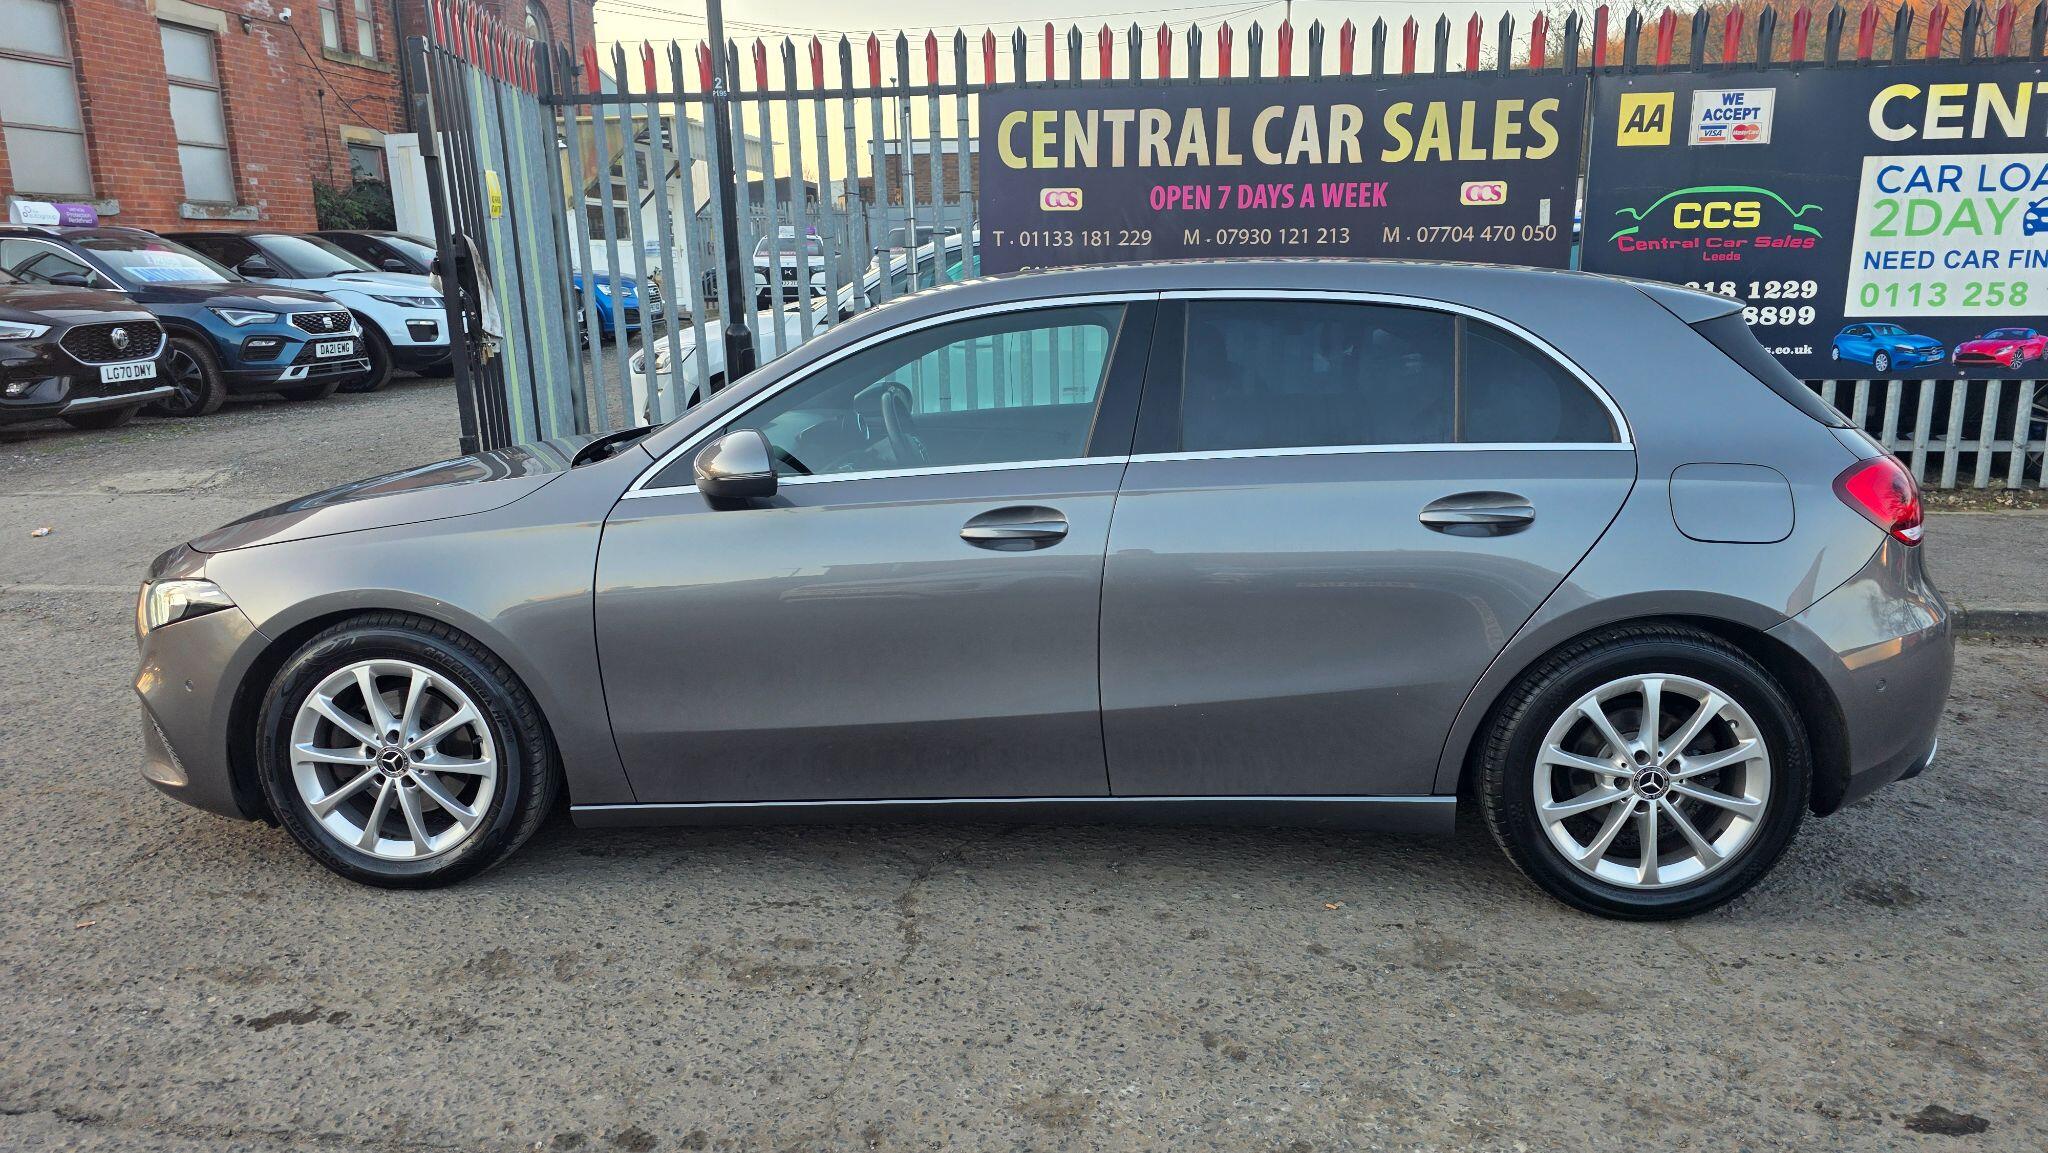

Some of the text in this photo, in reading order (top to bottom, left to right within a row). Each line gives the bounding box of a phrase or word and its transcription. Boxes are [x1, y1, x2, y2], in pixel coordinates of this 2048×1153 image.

[714, 77, 722, 89] 2
[1722, 92, 1744, 105] WE
[1623, 104, 1665, 133] AA
[1702, 107, 1761, 121] ACCEPT
[997, 98, 1560, 169] CENTRAL CAR SALES
[1704, 129, 1722, 137] VISA
[1732, 129, 1760, 137] MasterCard
[1876, 162, 2048, 194] CAR LOA
[1044, 191, 1078, 208] CCS
[1150, 181, 1389, 211] OPEN 7 DAYS A WEEK
[1465, 184, 1502, 202] CCS
[1673, 201, 1760, 229] CCS
[1870, 197, 2020, 237] 2DAY
[1019, 230, 1073, 247] 01133
[1081, 230, 1110, 247] 181
[1117, 229, 1152, 246] 229
[1216, 228, 1272, 245] 07930
[1279, 228, 1308, 244] 121
[1316, 227, 1350, 244] 213
[1416, 226, 1475, 243] 07704
[1480, 225, 1515, 242] 470
[1521, 224, 1557, 242] 050
[1617, 234, 1816, 252] Central Car Sales
[1702, 251, 1741, 261] Leeds
[1863, 249, 2048, 270] NEED CAR FIN
[1747, 280, 1818, 299] 1229
[1860, 281, 2029, 308] 0113 258
[1742, 305, 1816, 326] 8899
[320, 344, 336, 355] DA21
[1762, 344, 1813, 355] s.co.uk
[105, 364, 152, 380] LG70 DMY
